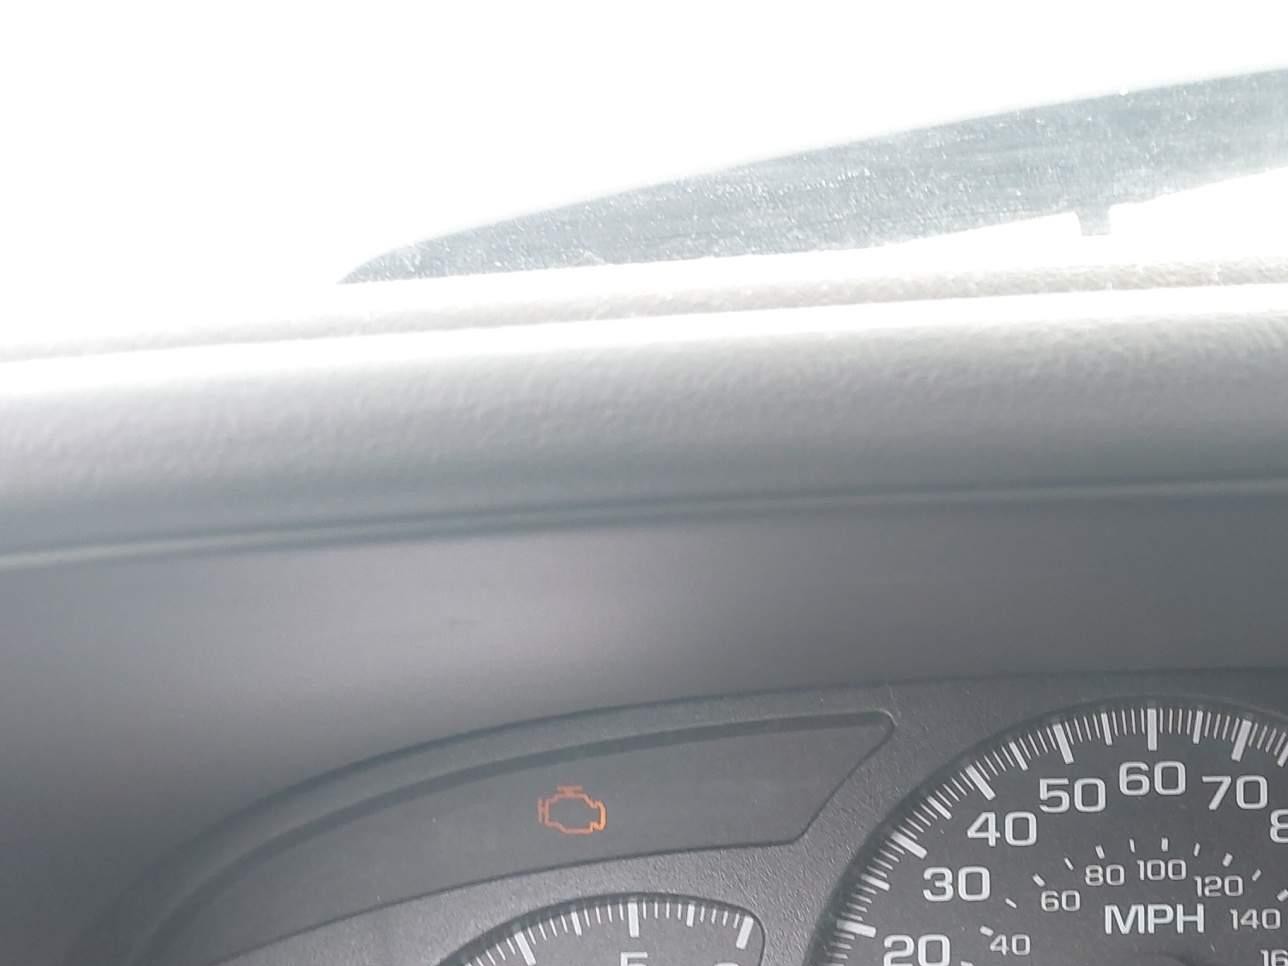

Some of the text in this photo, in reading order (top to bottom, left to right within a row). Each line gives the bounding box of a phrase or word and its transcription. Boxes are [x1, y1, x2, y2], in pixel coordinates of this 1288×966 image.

[1119, 760, 1186, 796] 60
[1039, 778, 1106, 814] 50
[1202, 775, 1268, 810] 70
[967, 812, 1037, 847] 40
[1085, 864, 1124, 886] 80
[1137, 859, 1186, 880] 100
[922, 866, 991, 902] 30
[1195, 876, 1243, 896] 120
[1040, 890, 1081, 912] 60
[1104, 904, 1204, 934] MPH
[1230, 909, 1281, 930] 140
[990, 934, 1030, 956] 40
